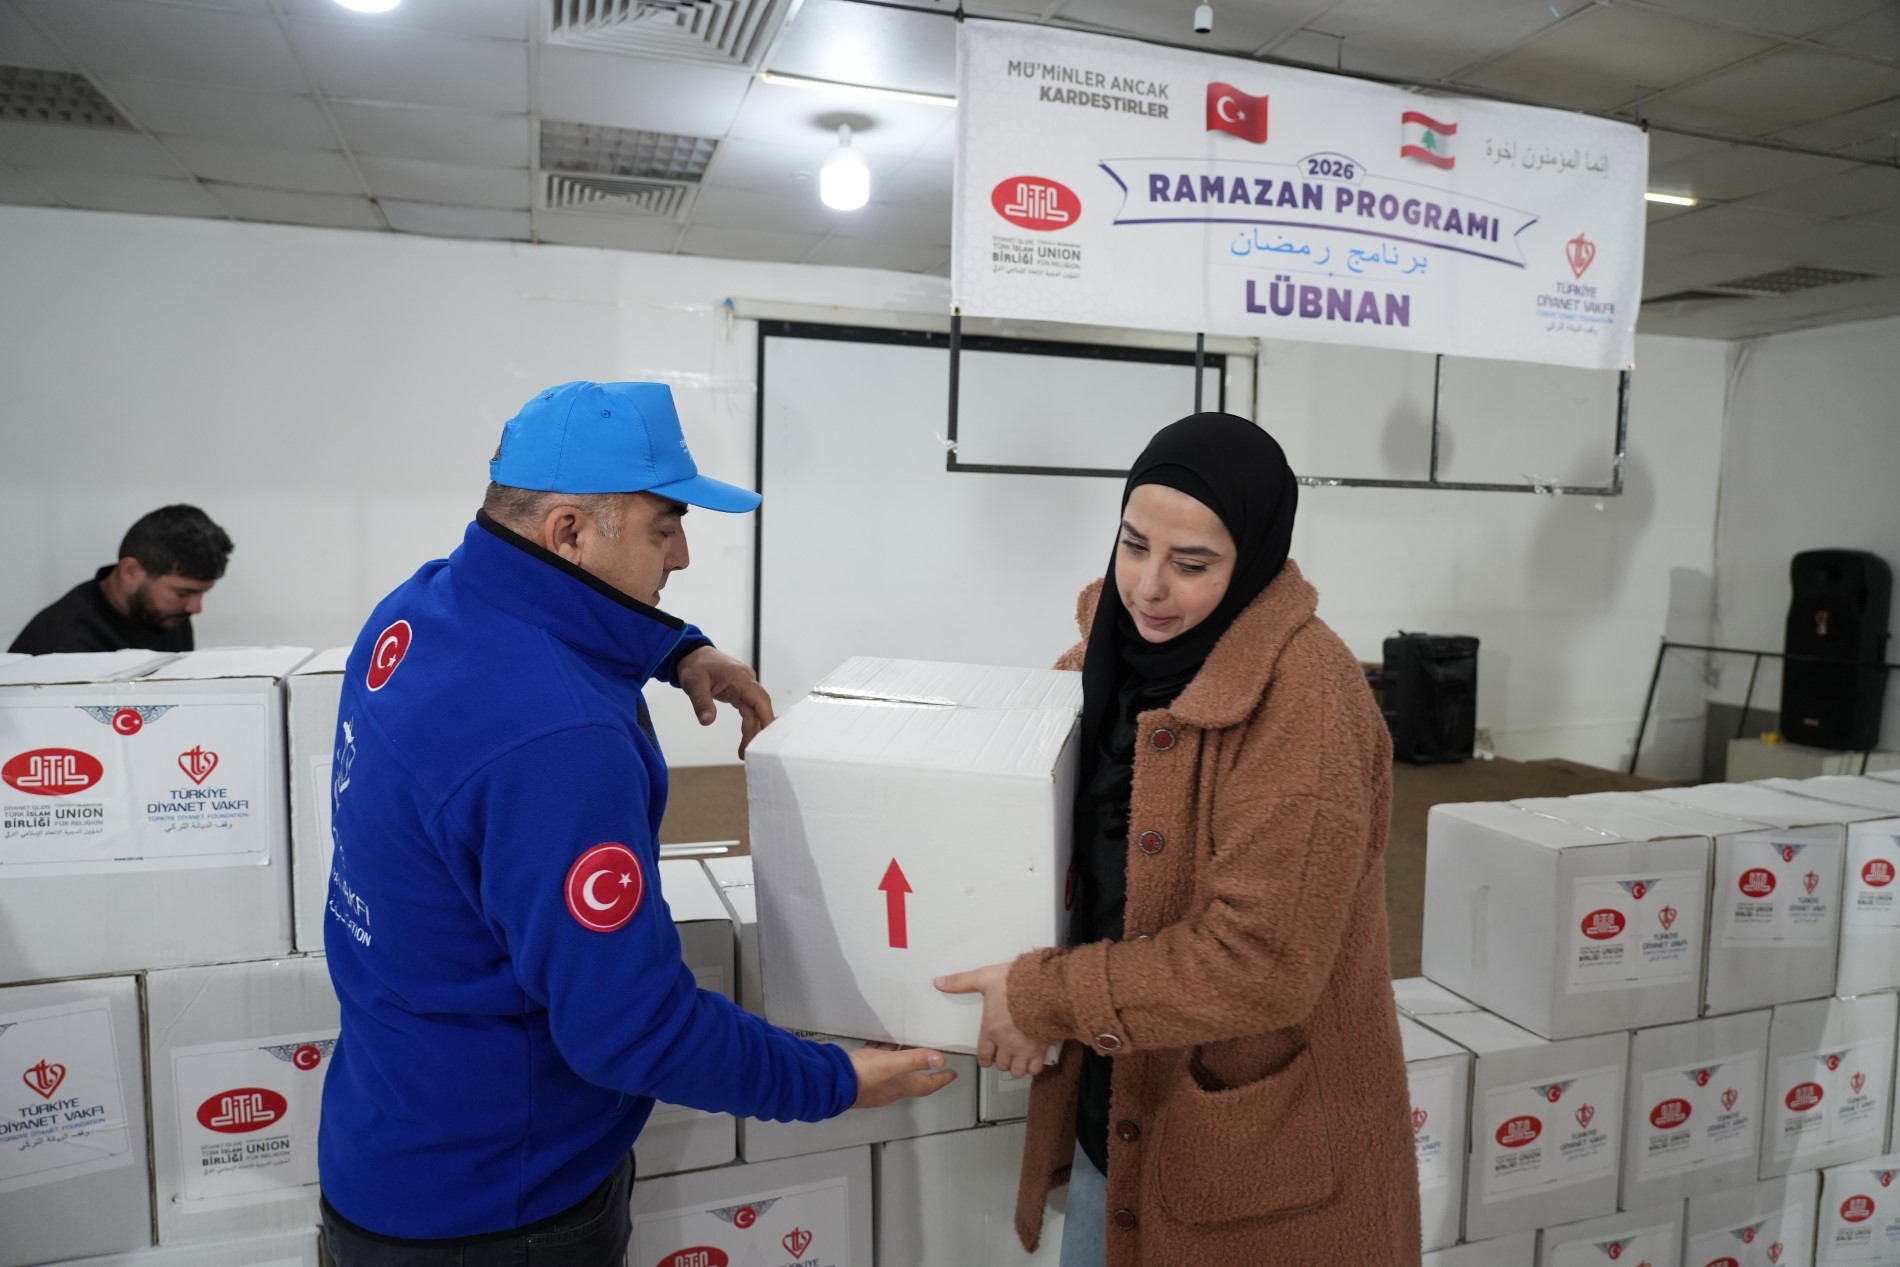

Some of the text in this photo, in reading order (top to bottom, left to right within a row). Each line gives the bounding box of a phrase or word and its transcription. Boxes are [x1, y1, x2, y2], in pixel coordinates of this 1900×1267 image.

[1111, 76, 1169, 99] ANCAK
[1040, 86, 1169, 119] KARDEŞTİRLER
[1308, 158, 1354, 180] 2026
[1149, 173, 1499, 242] RAMAZAN PROGRAMI
[1037, 246, 1081, 262] UNION
[1231, 227, 1428, 274] برنامج رمضان
[1246, 274, 1410, 327] LÜBNAN
[169, 787, 227, 800] TÜRKİYE
[55, 808, 103, 819] UNION
[147, 800, 249, 814] DİYANET VAKFI
[207, 812, 249, 820] FOUNDATION
[4, 817, 51, 828] BİRLİĞİ
[19, 1097, 80, 1118] TÜRKİYE
[0, 1105, 105, 1135] DİYANET VAKFI
[246, 1139, 290, 1154] UNION
